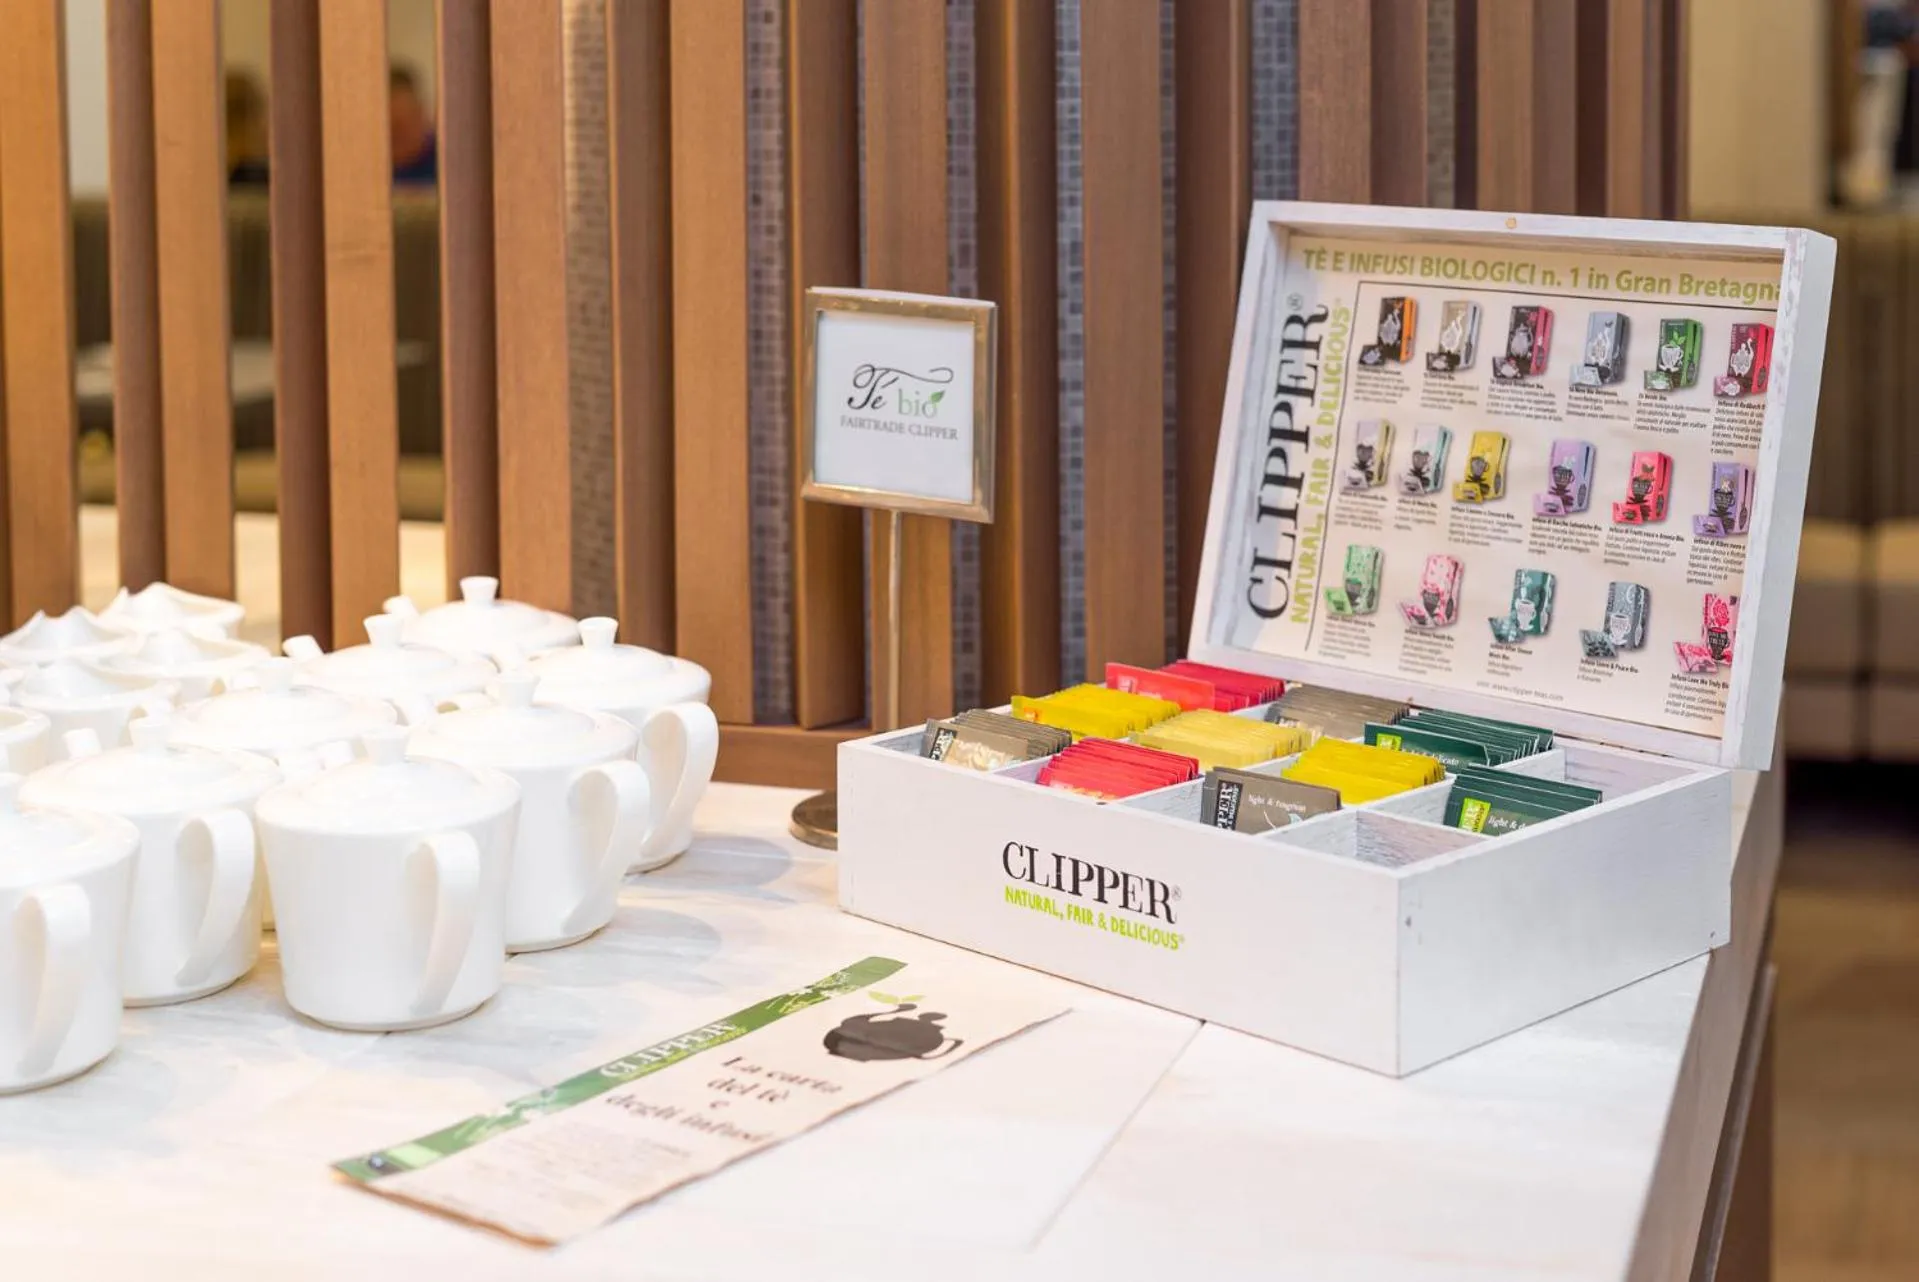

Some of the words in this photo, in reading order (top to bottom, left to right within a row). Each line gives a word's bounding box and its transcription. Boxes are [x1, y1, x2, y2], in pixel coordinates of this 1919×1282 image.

[1304, 247, 1327, 272] TÈ
[1332, 251, 1345, 272] E
[1350, 252, 1414, 276] INFUSI
[1420, 256, 1536, 285] BIOLOGICI
[1541, 268, 1561, 287] n.
[1570, 266, 1580, 288] 1
[1587, 267, 1609, 291] in
[1615, 269, 1672, 294] Gran
[898, 388, 941, 419] bio
[840, 415, 904, 434] FAIRTRADE
[908, 424, 958, 440] CLIPPER
[1315, 430, 1333, 449] &
[1305, 457, 1331, 507] FAIR
[1005, 885, 1064, 920] NATURAL,
[1067, 904, 1094, 926] FAIR
[1098, 913, 1107, 931] &
[707, 1078, 759, 1096] del
[721, 1056, 762, 1075] La
[766, 1065, 843, 1093] carta
[605, 1094, 684, 1119] degli
[680, 1110, 774, 1142] infusi
[709, 1099, 731, 1109] e
